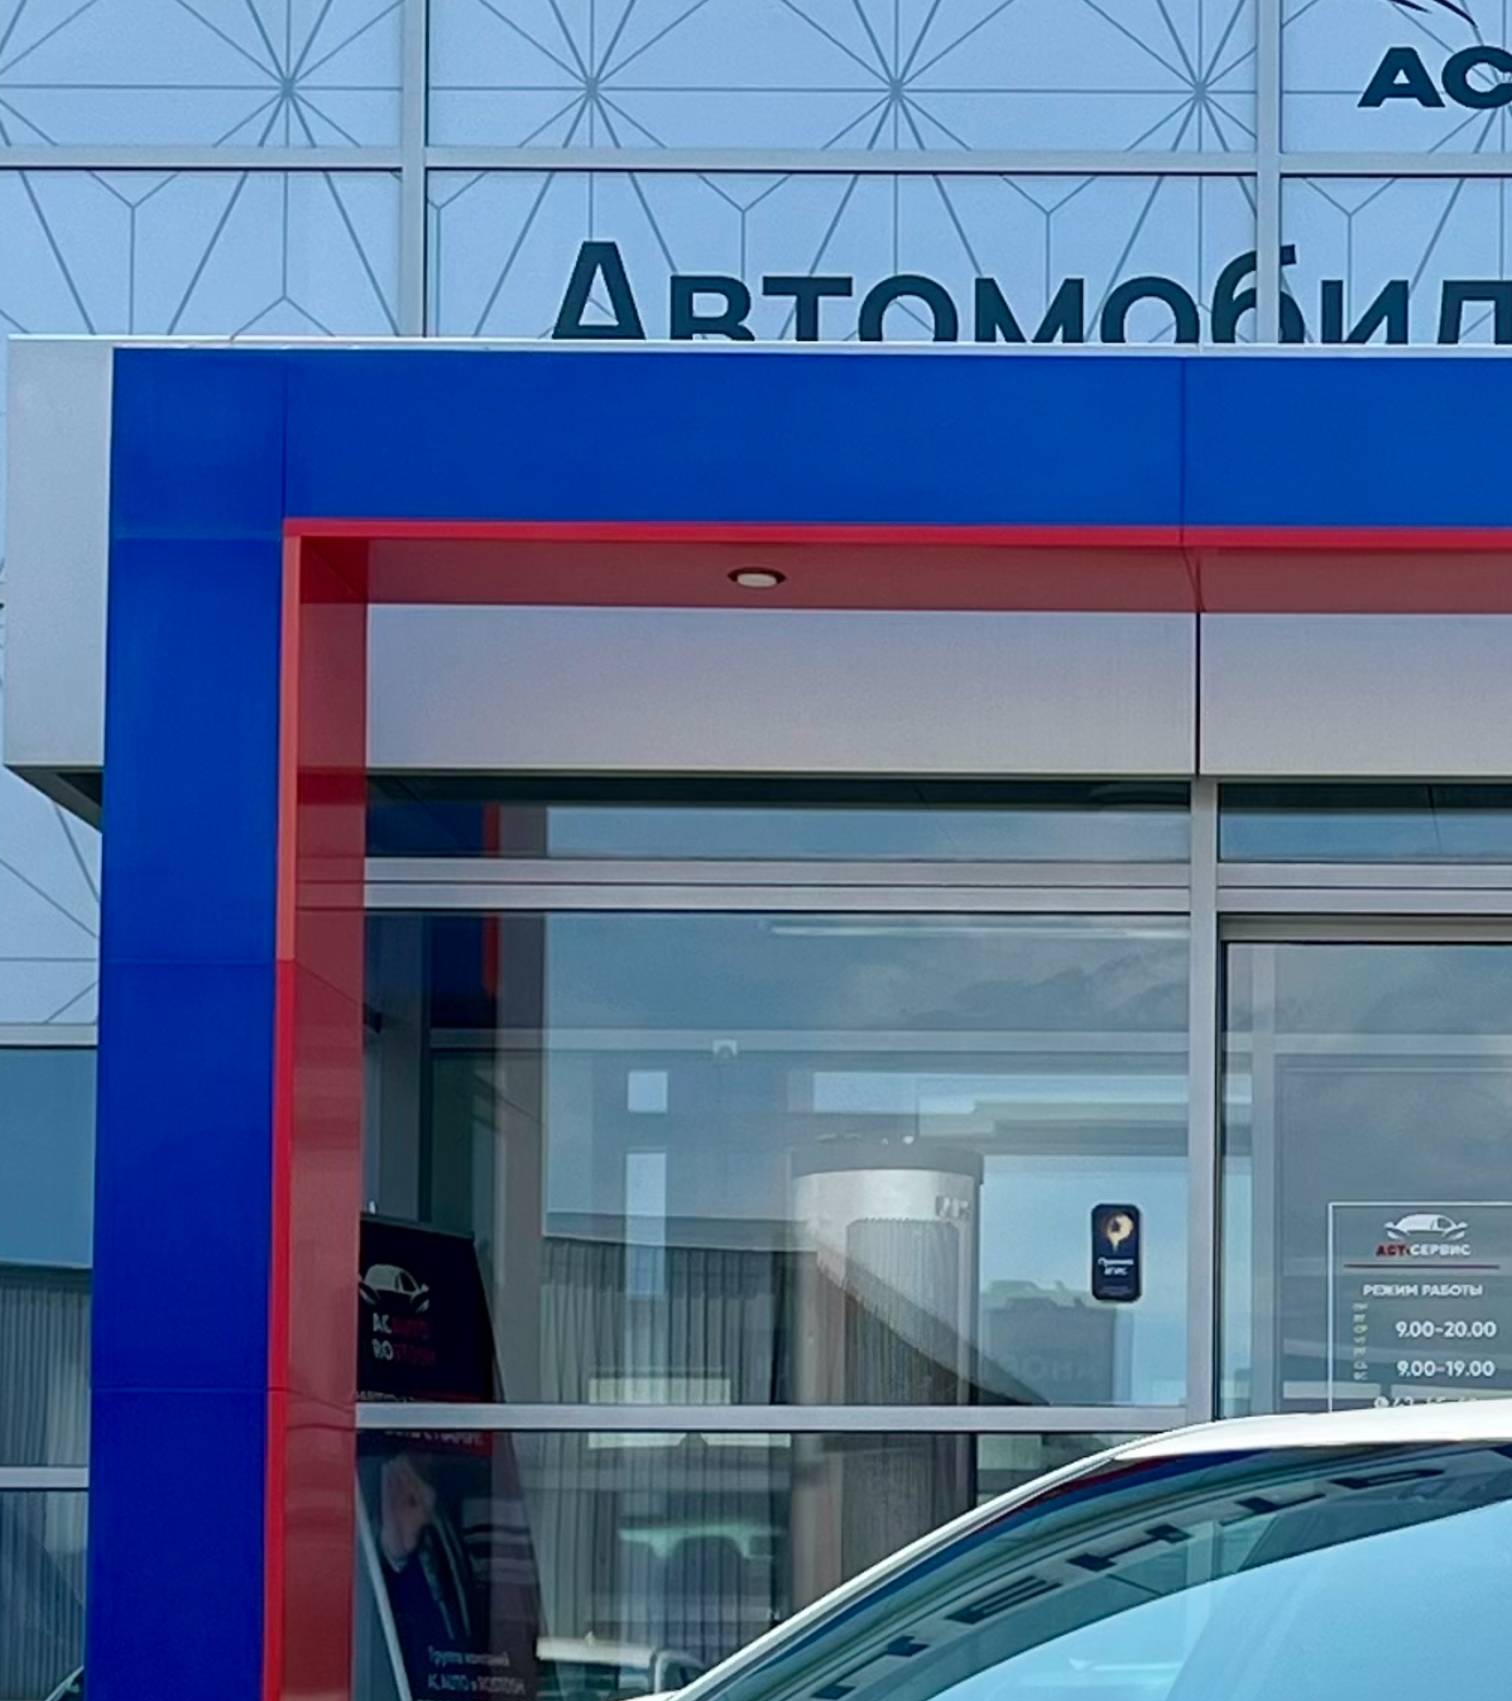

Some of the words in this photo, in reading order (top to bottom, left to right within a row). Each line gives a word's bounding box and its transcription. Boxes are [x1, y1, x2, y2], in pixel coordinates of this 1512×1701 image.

[1362, 1284, 1419, 1296] РЕЖИМ
[1421, 1284, 1483, 1296] РАБОТЫ
[1395, 1321, 1497, 1338] 9.00-20.00
[1396, 1360, 1496, 1377] 9.00-19.00
